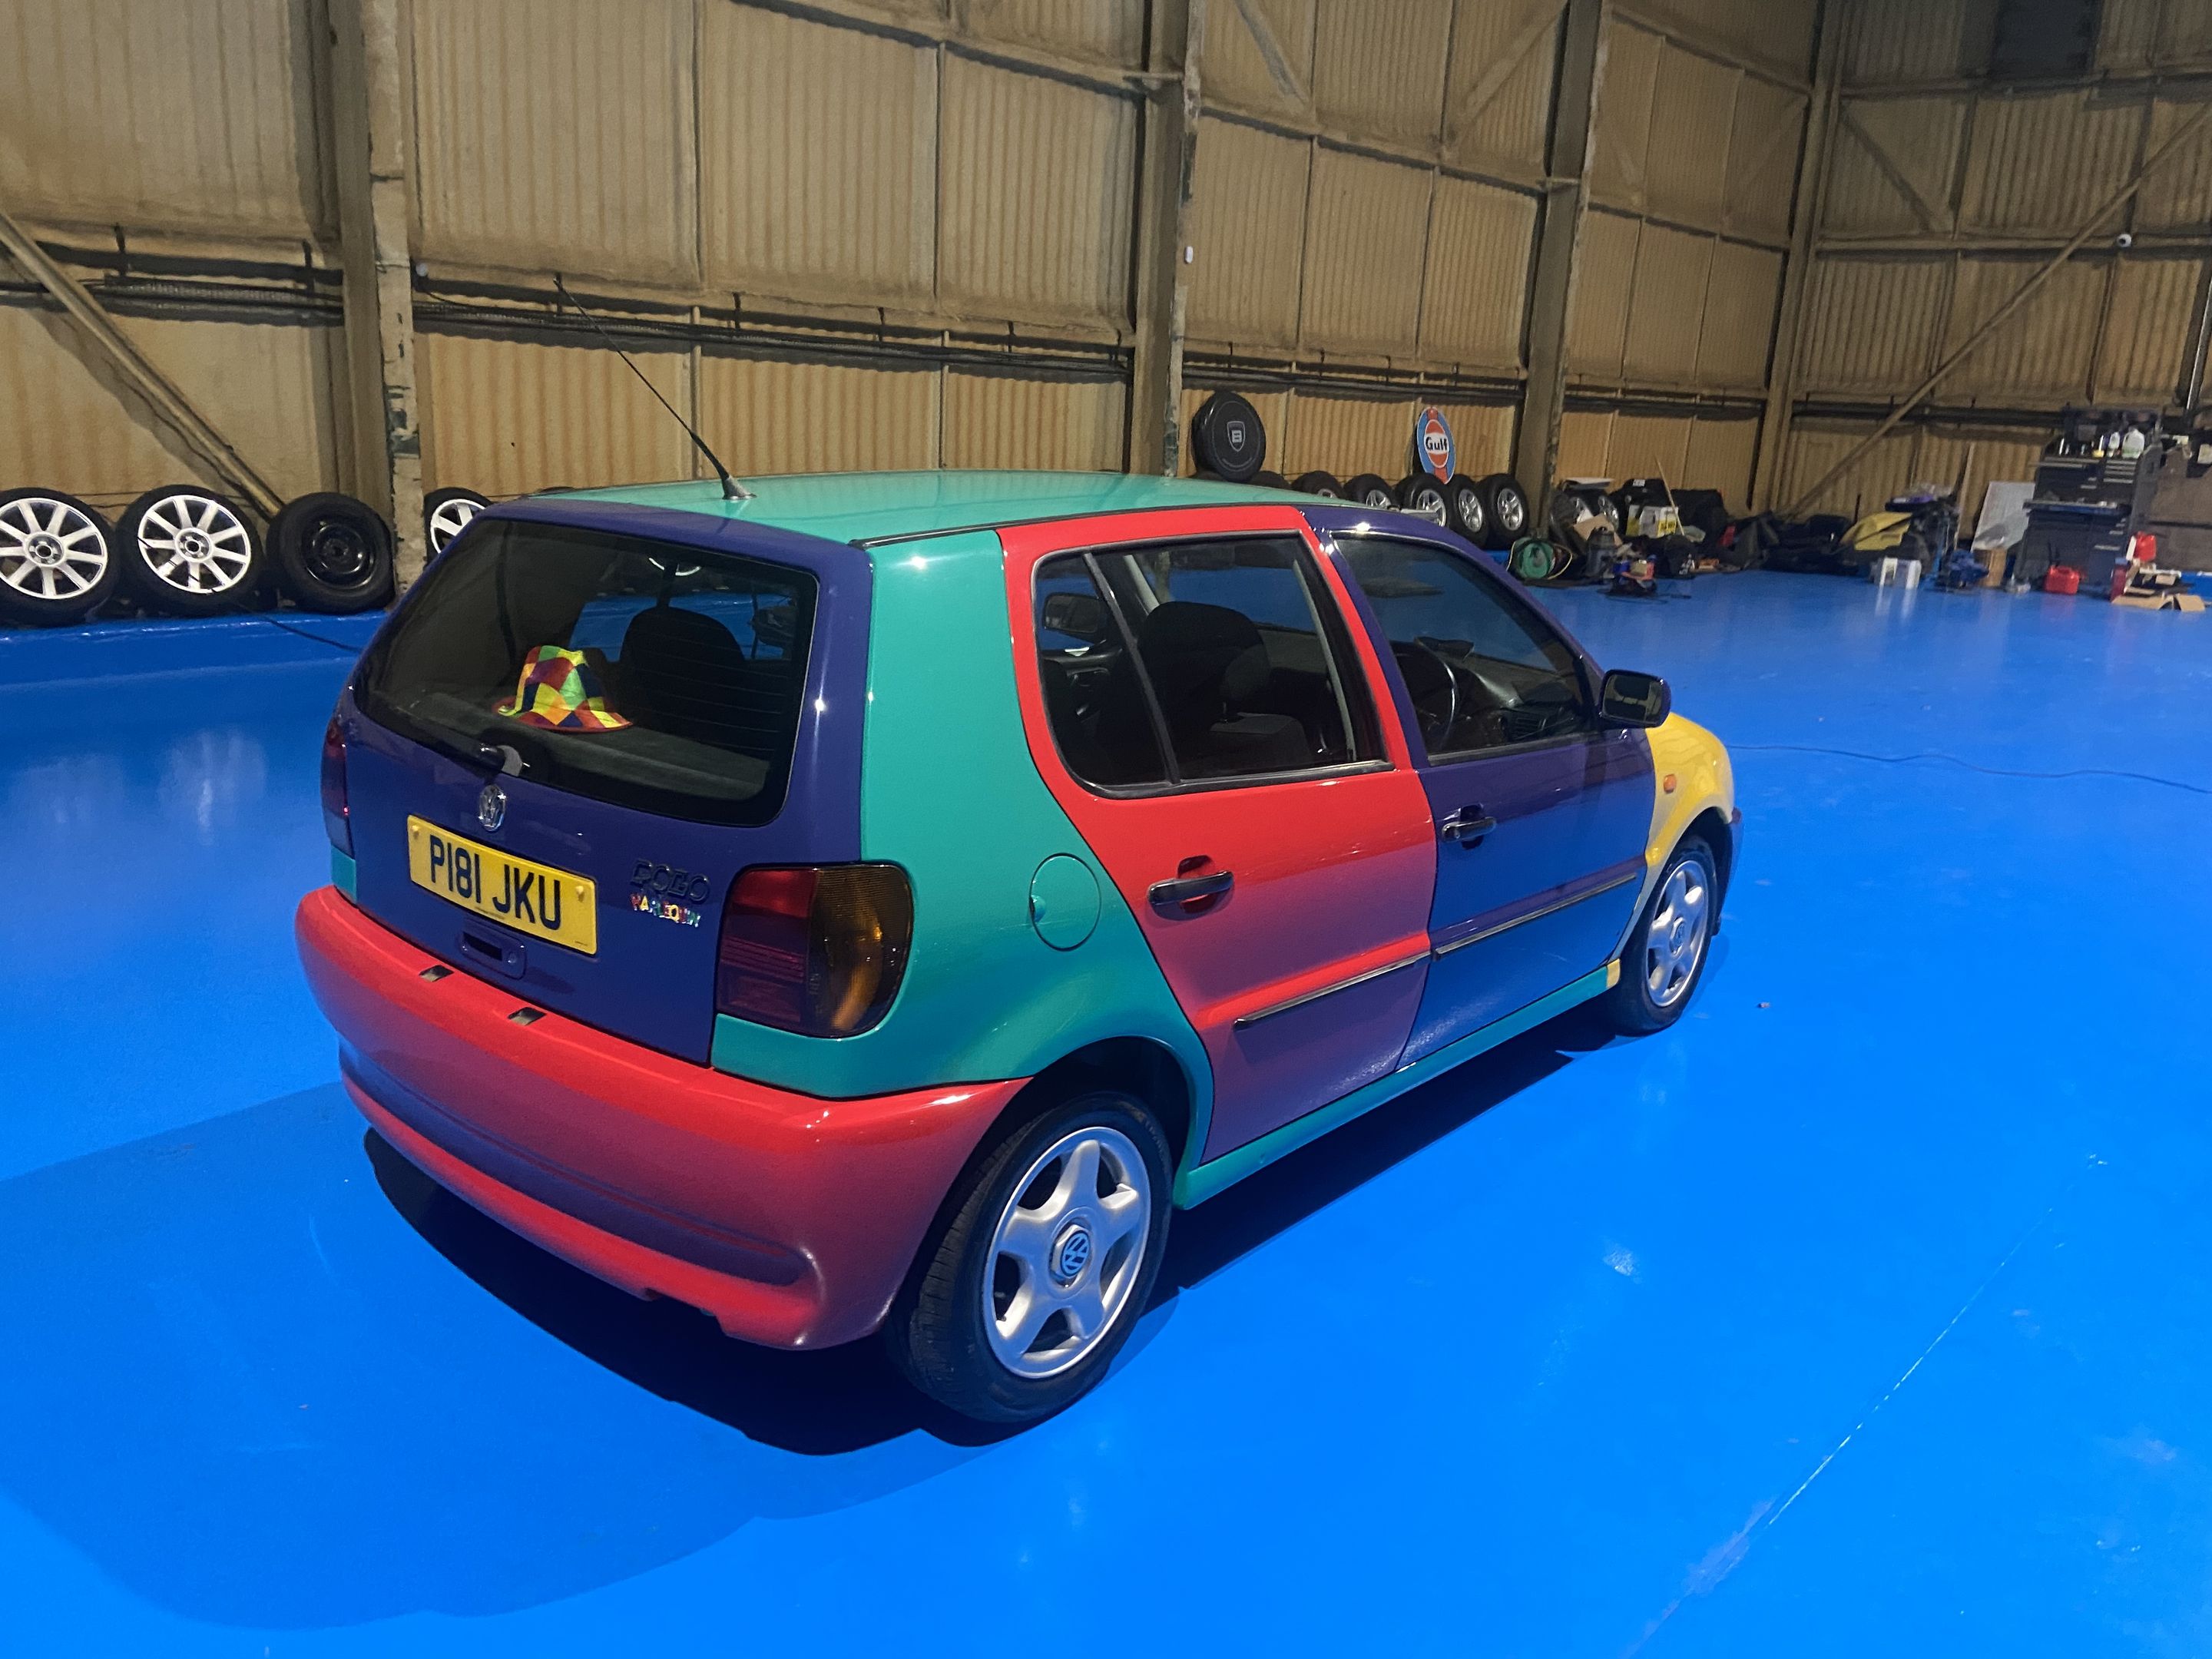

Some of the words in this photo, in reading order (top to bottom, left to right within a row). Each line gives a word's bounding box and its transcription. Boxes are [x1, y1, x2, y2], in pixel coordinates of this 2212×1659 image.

[1426, 436, 1448, 451] Gulf
[430, 834, 481, 904] P181
[492, 864, 561, 930] JKU
